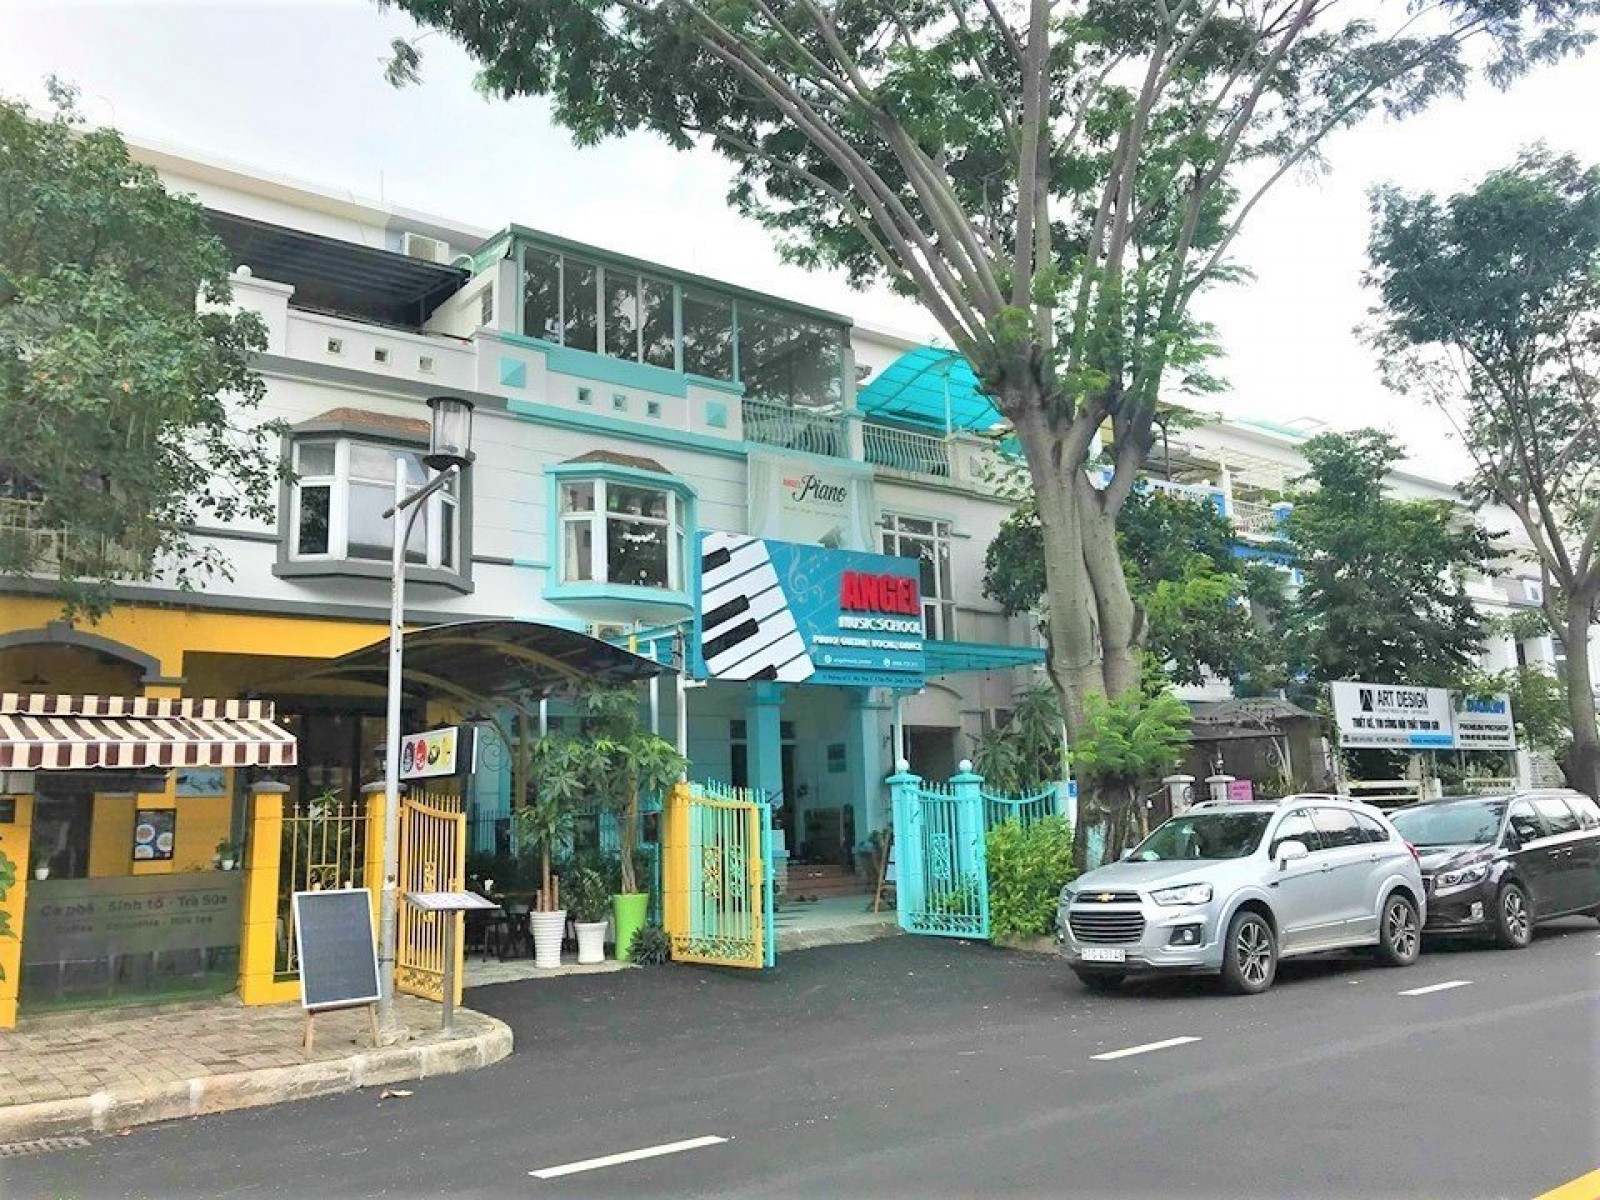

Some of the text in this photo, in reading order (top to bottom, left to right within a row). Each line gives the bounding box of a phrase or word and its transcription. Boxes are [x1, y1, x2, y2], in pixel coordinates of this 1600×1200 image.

[792, 474, 847, 502] Piano
[841, 570, 921, 616] ANGEL
[838, 616, 922, 634] MUSIC SCHOOL
[1378, 689, 1429, 709] ART DESIGN
